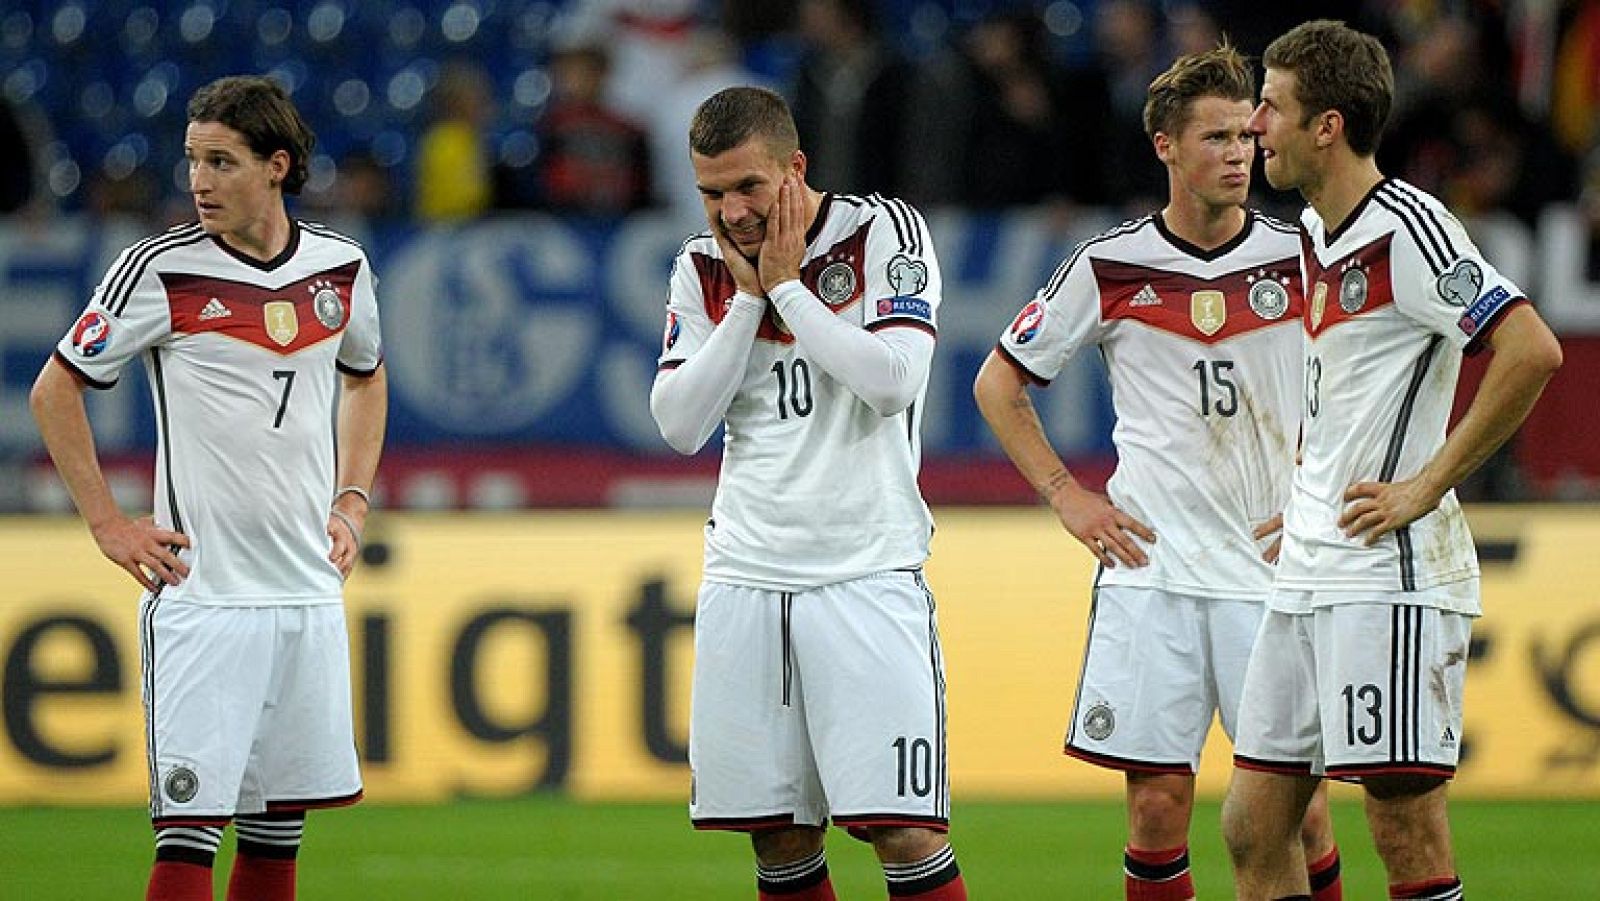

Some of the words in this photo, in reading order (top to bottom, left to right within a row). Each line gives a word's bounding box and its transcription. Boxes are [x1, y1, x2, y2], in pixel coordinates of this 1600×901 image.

[273, 370, 297, 428] 7
[771, 358, 813, 419] 10
[1193, 360, 1238, 417] 15
[1341, 684, 1382, 745] 13
[891, 736, 932, 797] 10
